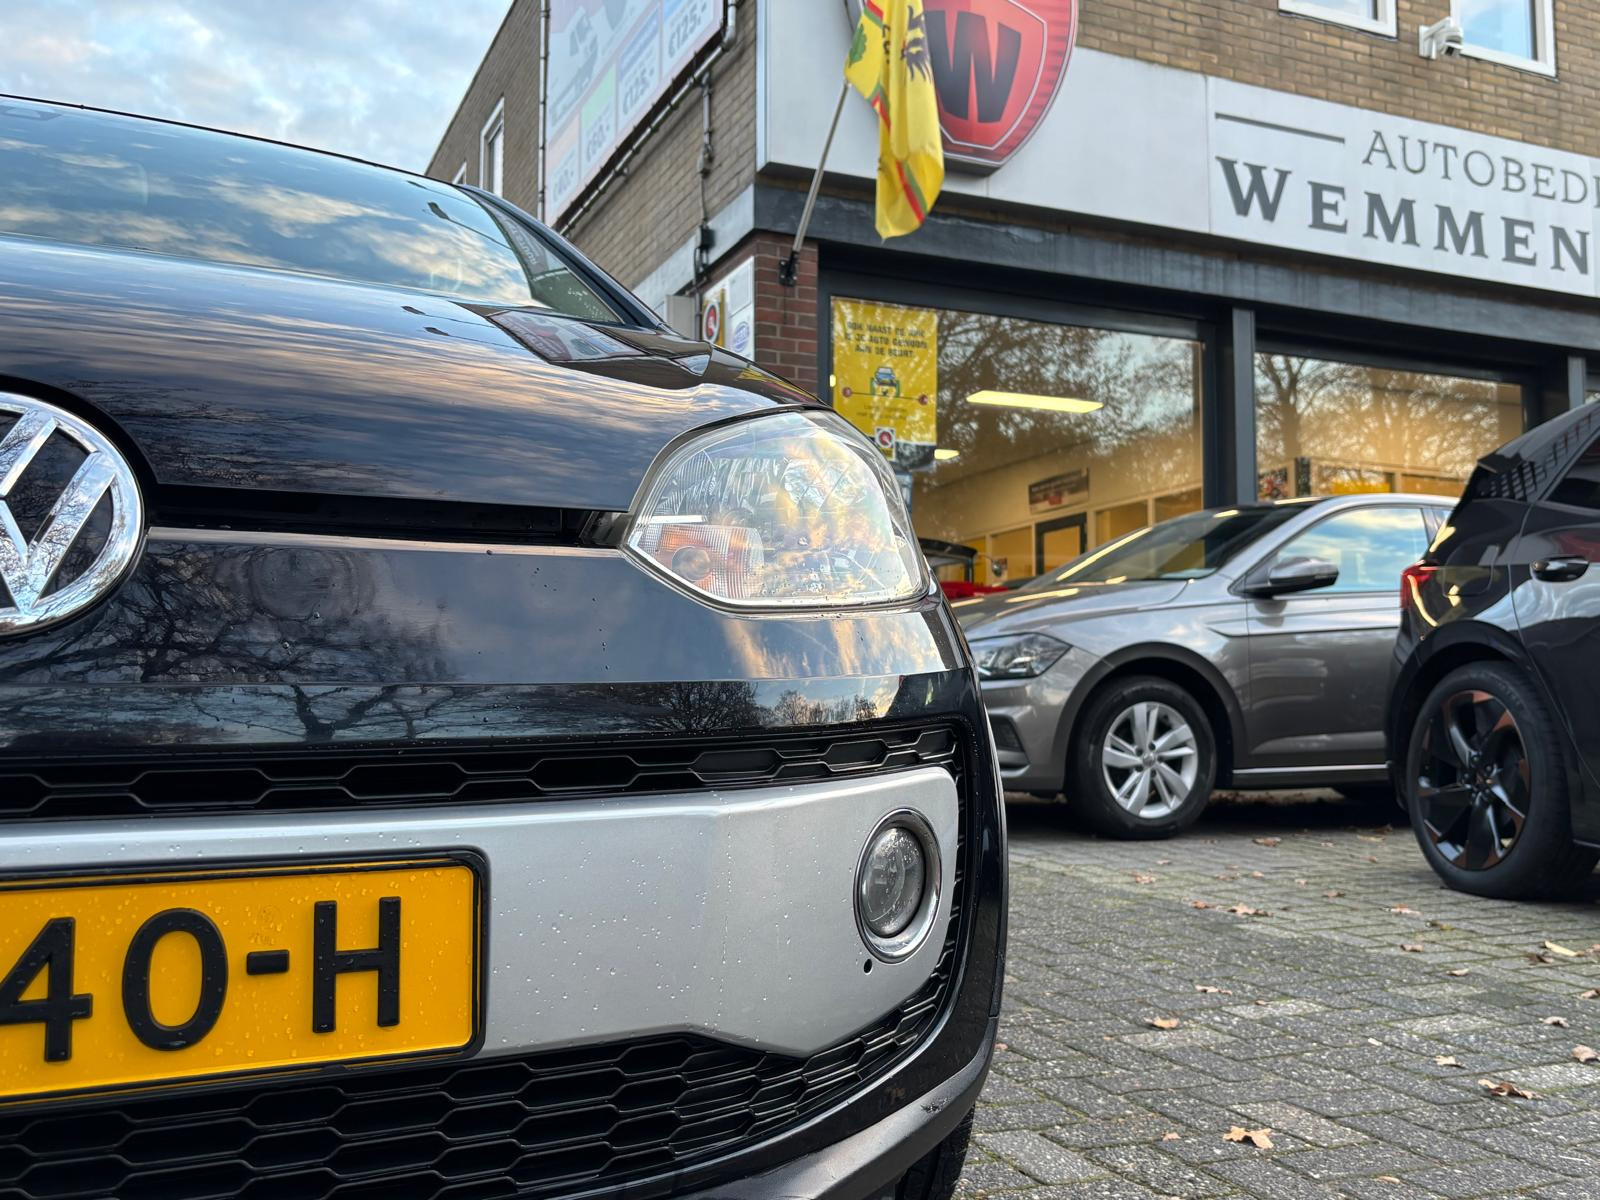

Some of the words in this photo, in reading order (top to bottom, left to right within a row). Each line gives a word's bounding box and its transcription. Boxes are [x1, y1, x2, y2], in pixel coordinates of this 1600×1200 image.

[1215, 156, 1590, 275] WEMMEN
[1362, 129, 1600, 209] AUTOBED
[0, 895, 401, 1063] 40-H
